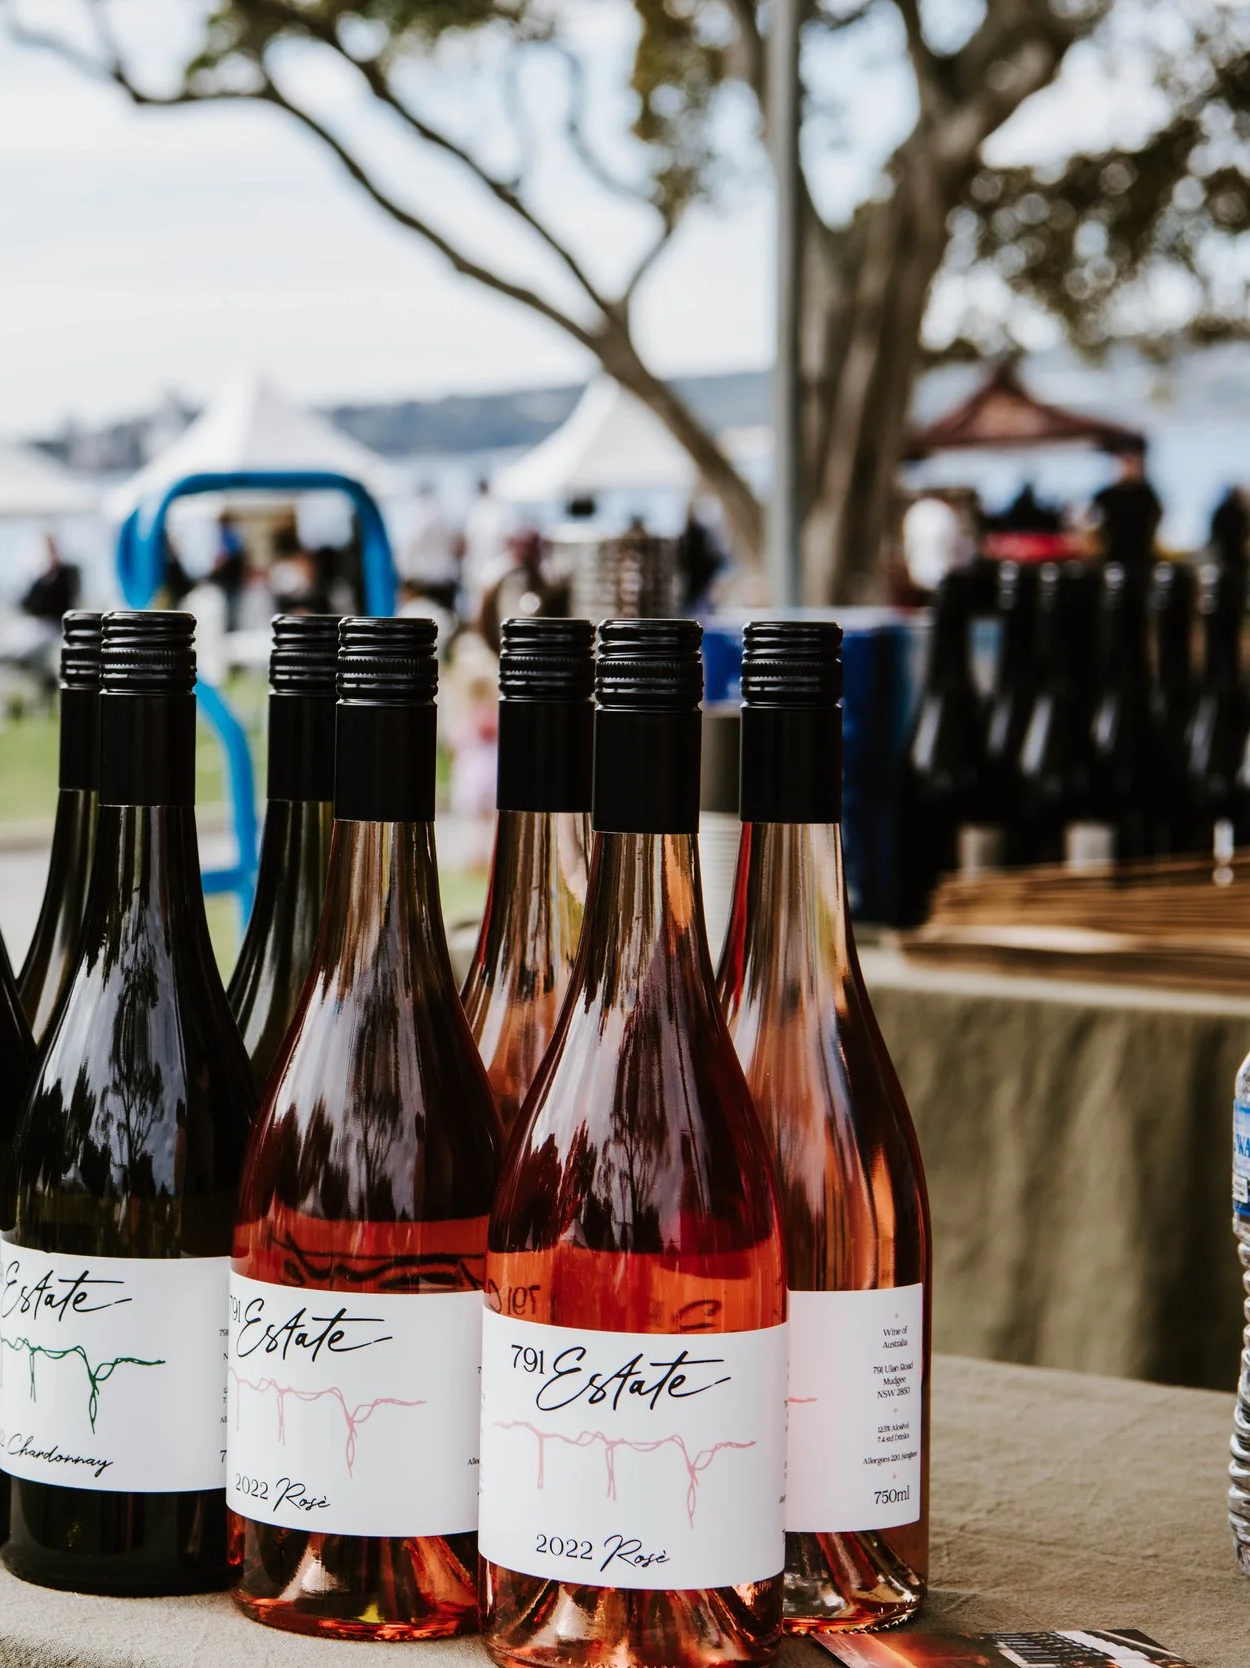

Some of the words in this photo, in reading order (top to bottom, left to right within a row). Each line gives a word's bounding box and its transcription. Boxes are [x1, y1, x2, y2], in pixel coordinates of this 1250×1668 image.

[2, 1260, 132, 1322] Estate
[237, 1298, 393, 1362] Estate
[883, 1327, 901, 1336] Wine
[902, 1325, 908, 1334] of
[882, 1339, 908, 1349] Australia
[510, 1344, 545, 1375] 791
[536, 1346, 732, 1411] Estate
[900, 1361, 914, 1371] Road
[877, 1389, 896, 1399] NSW
[8, 1433, 114, 1478] Chardonnay
[235, 1473, 269, 1500] 2022
[874, 1485, 910, 1504] 750ml
[536, 1534, 593, 1560] 2022
